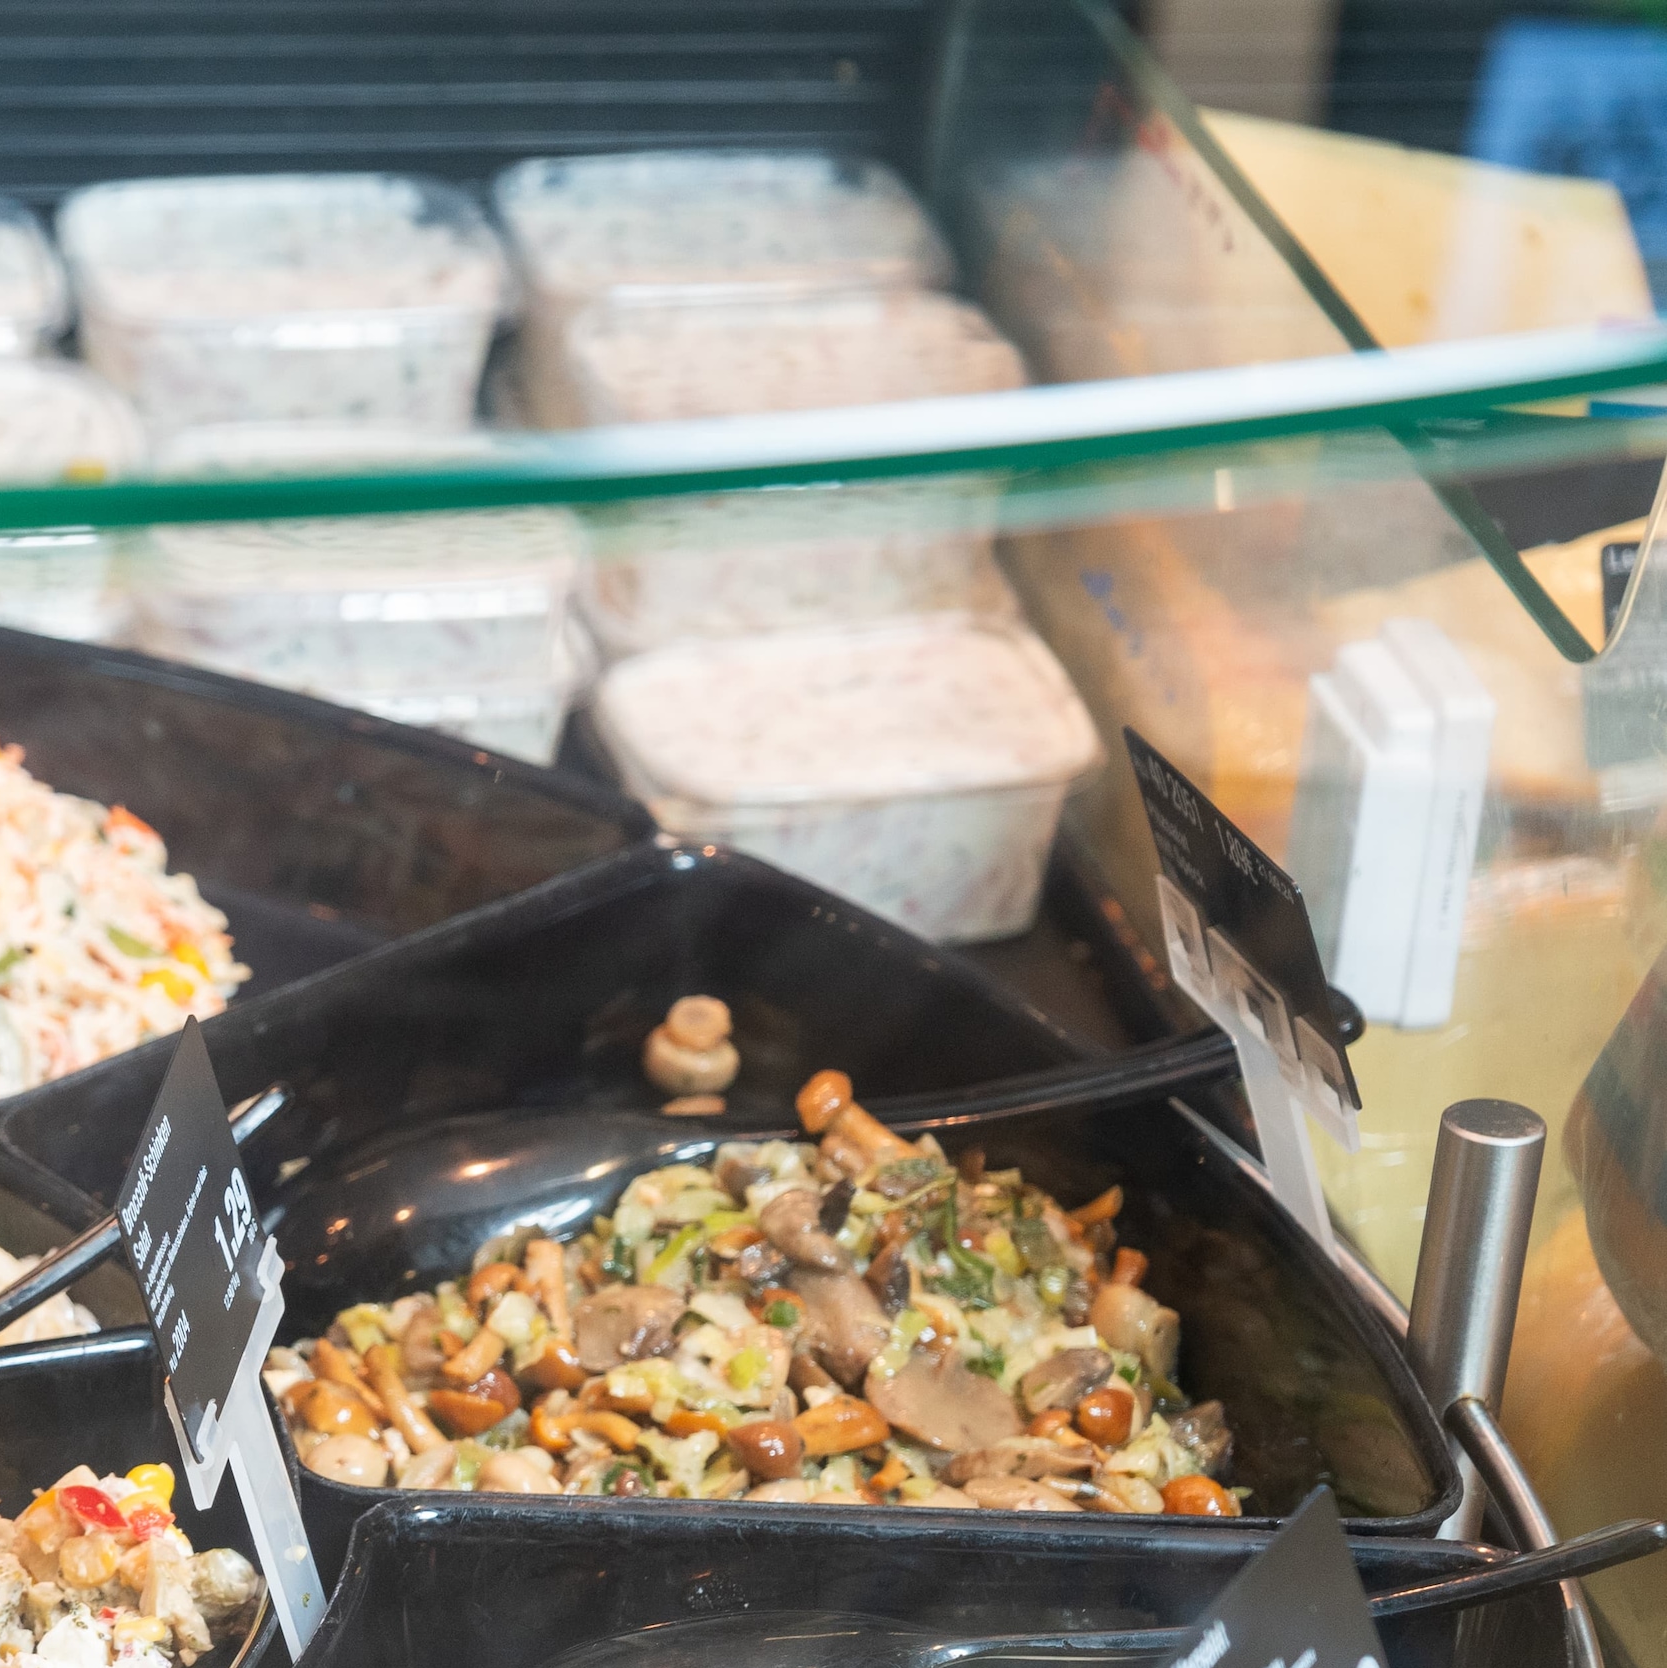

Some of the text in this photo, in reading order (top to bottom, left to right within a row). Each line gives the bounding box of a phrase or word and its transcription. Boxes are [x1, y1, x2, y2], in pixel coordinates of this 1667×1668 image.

[121, 1114, 172, 1237] Broccoli-Schinken
[132, 1220, 153, 1271] Salat
[214, 1167, 253, 1273] 1.29
[171, 1309, 192, 1357] 2004
